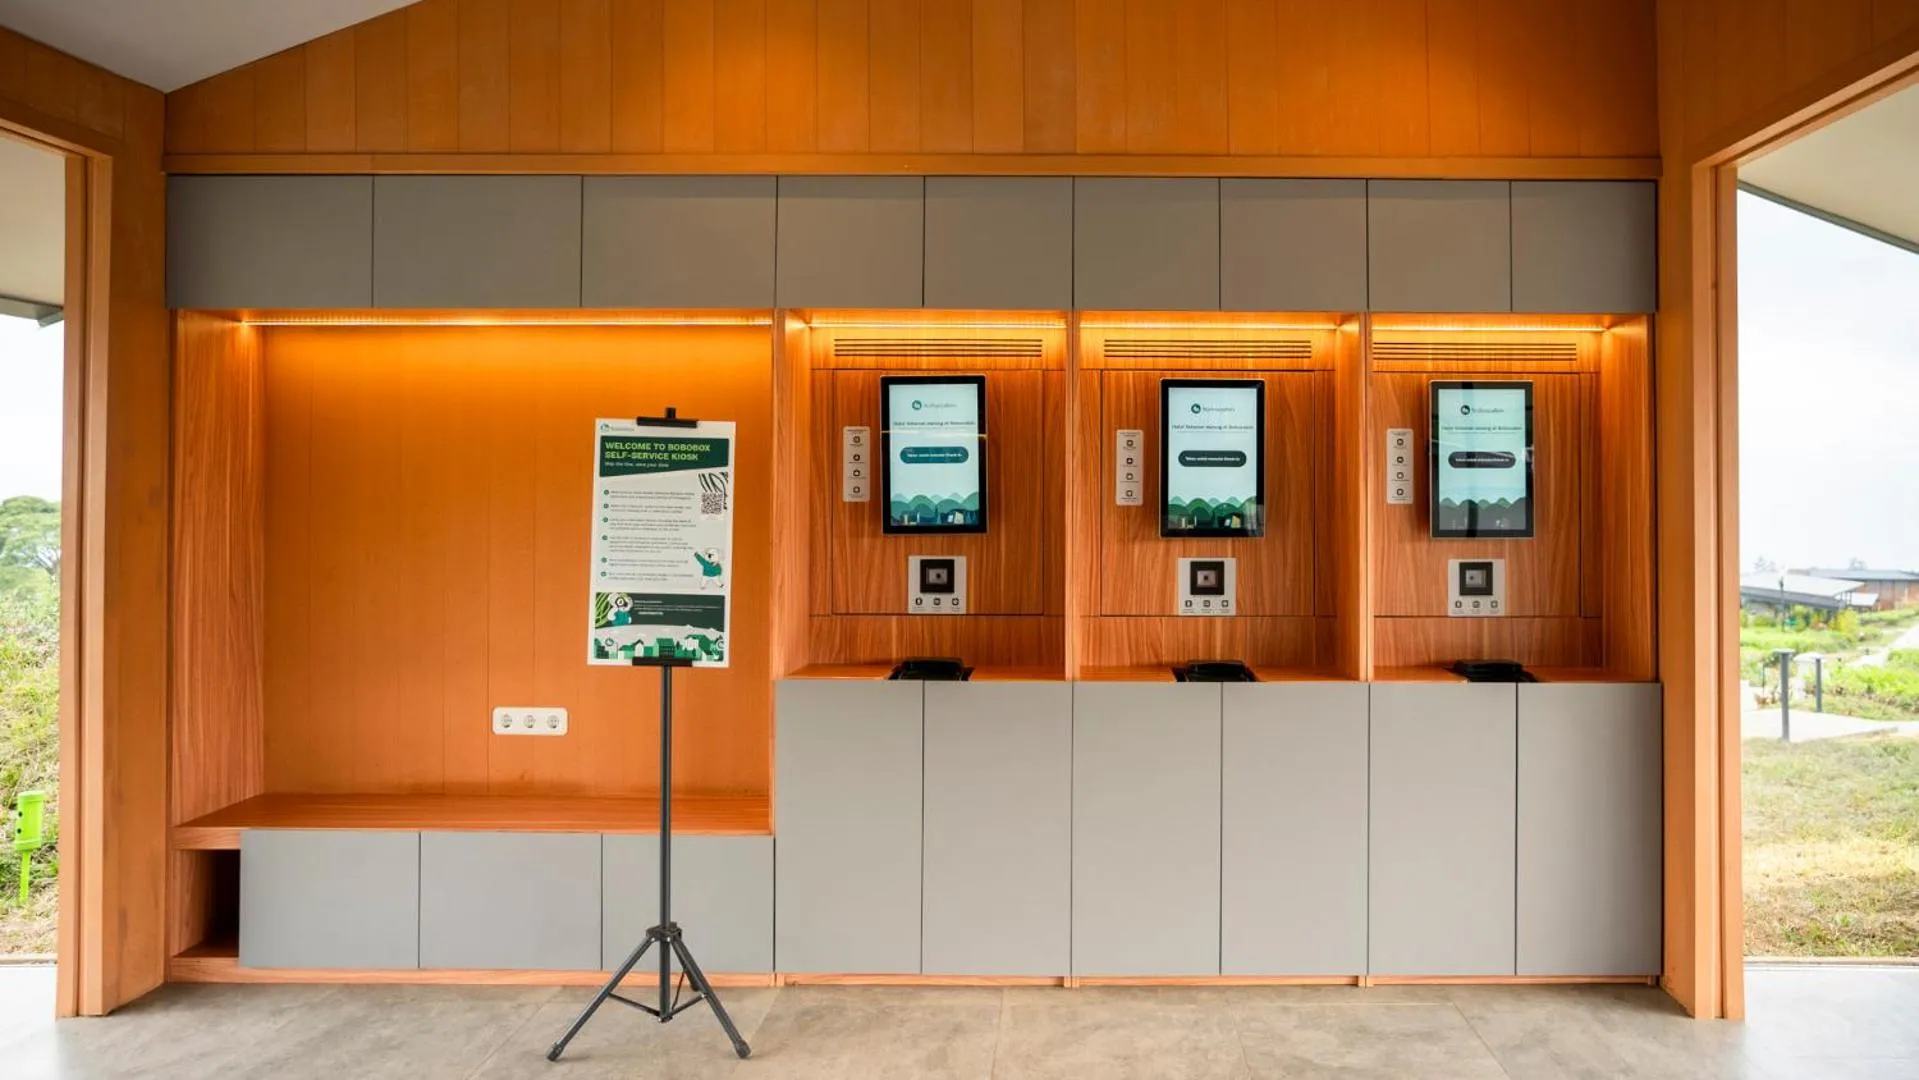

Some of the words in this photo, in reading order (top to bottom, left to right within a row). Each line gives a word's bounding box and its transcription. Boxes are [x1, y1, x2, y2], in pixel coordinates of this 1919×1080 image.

[605, 442, 652, 450] WELCOME
[654, 443, 666, 451] TO
[667, 443, 711, 452] BOBOBOX
[605, 451, 669, 460] SELF-SERVICE
[671, 453, 698, 461] KIOSK
